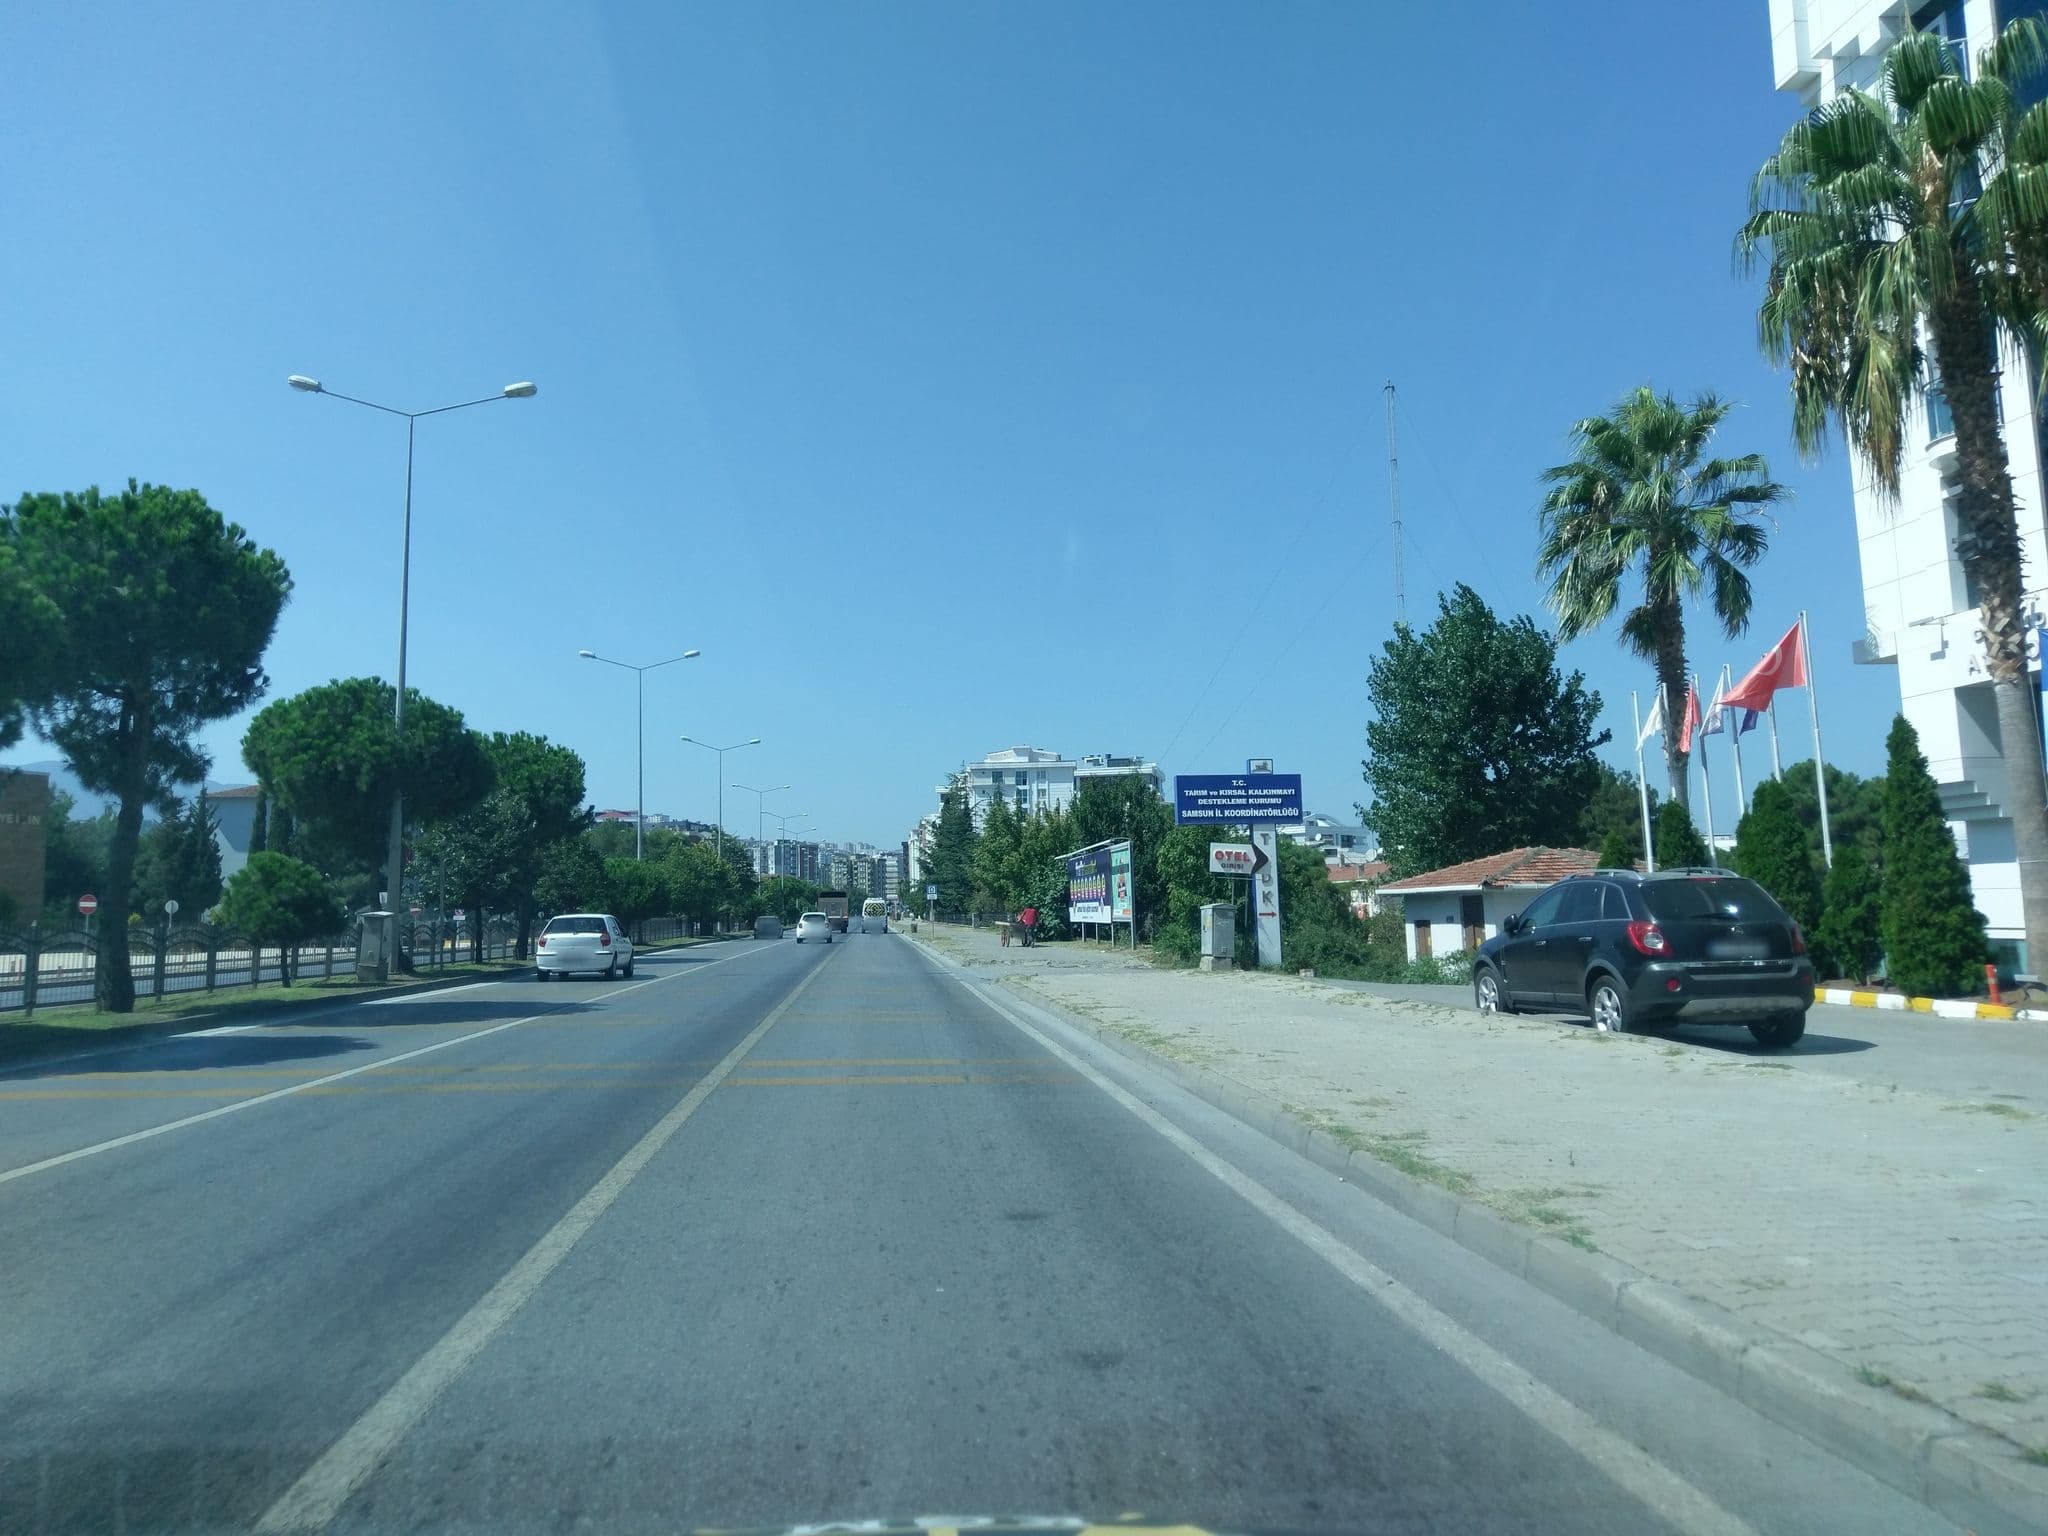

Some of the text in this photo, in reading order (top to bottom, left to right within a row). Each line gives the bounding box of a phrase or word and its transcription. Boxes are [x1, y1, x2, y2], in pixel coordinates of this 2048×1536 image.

[1182, 807, 1299, 818] SAMSUN İL KOORDİNATÖRLÜĞÜ
[1215, 850, 1250, 862] OTEL
